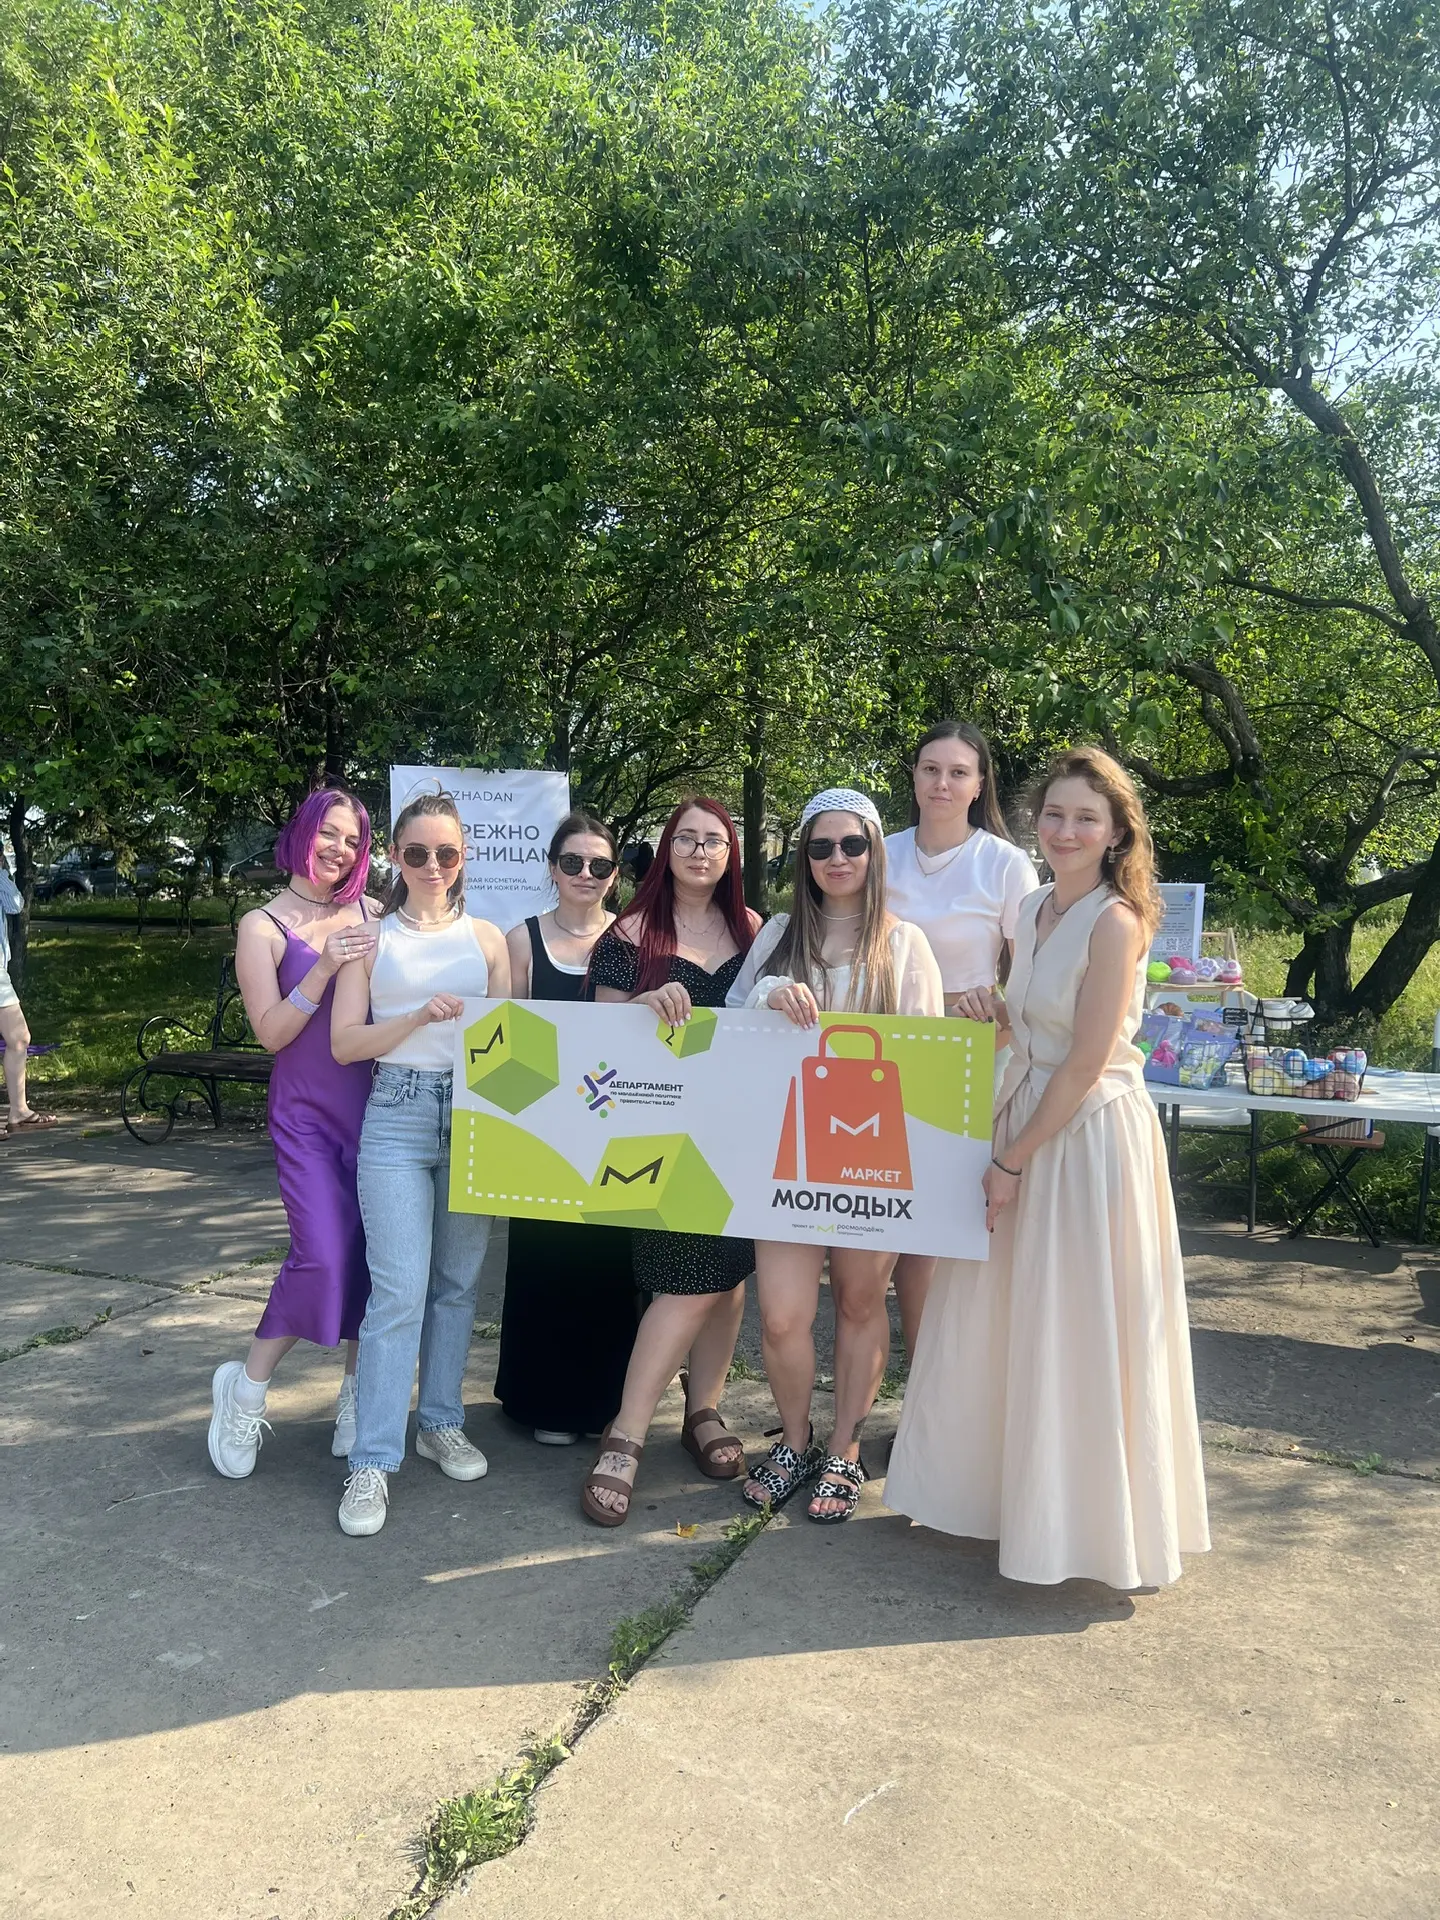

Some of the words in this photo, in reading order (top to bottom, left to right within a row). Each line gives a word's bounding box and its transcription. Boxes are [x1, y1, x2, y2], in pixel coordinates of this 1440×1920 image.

[461, 823, 540, 841] РЕЖНО
[608, 1080, 684, 1092] ДЕПАРТАМЕНТ
[840, 1166, 902, 1184] МАРКЕТ
[771, 1188, 913, 1220] МОЛОДЫХ
